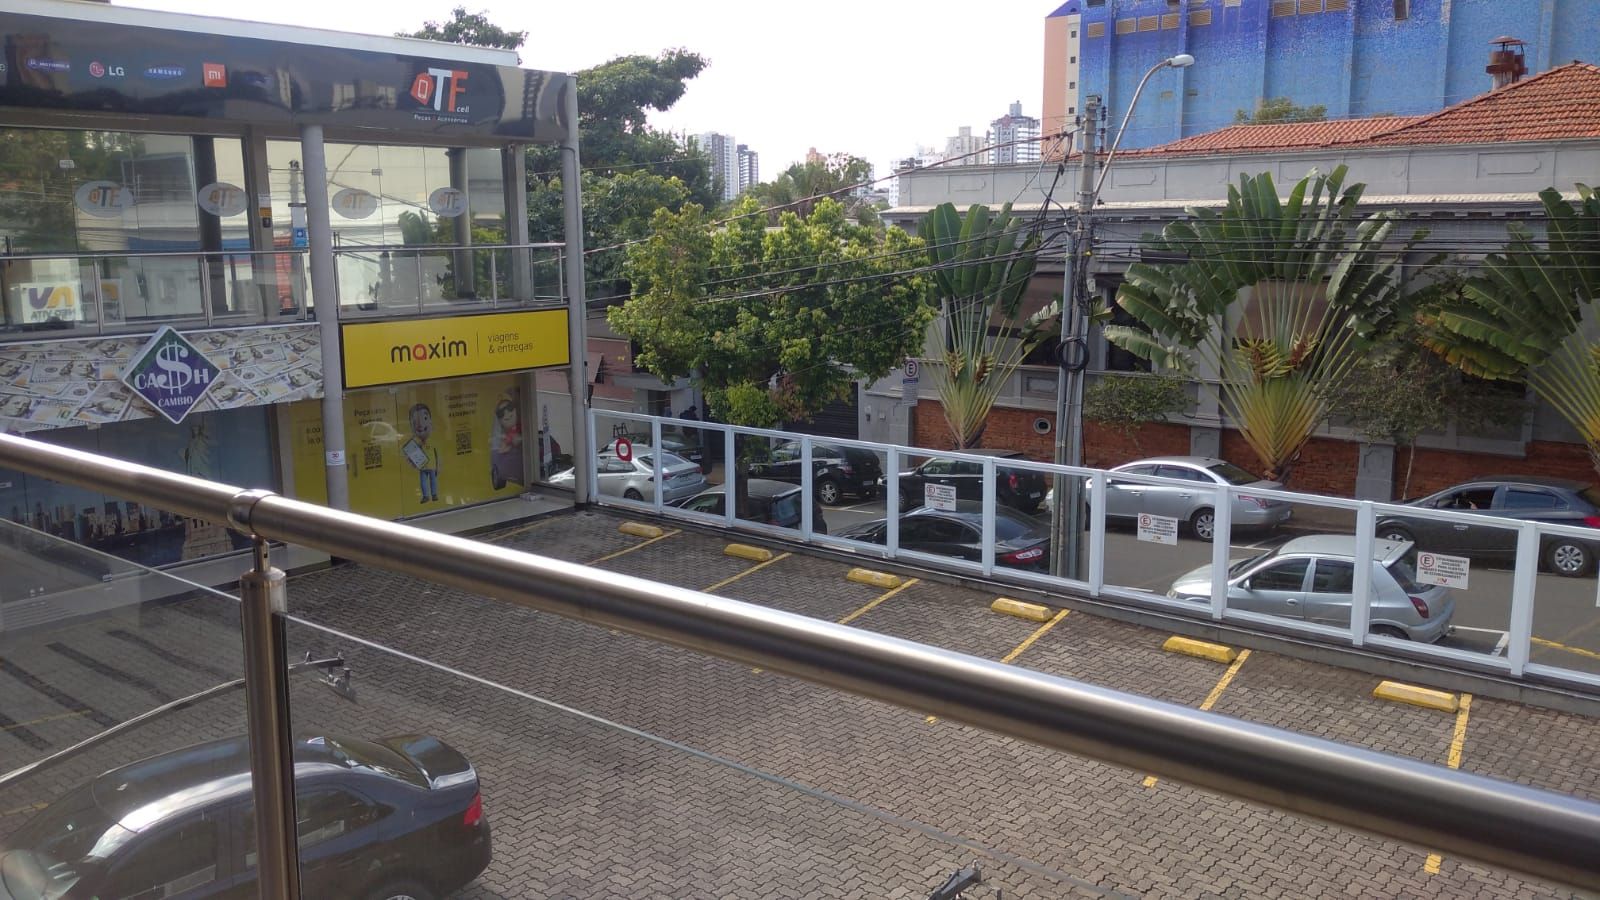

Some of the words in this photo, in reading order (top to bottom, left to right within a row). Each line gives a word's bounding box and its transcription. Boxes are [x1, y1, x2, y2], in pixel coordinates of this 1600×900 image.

[109, 66, 125, 76] LG
[456, 105, 470, 113] cell
[487, 331, 520, 344] viagens
[390, 335, 468, 363] maxim
[488, 344, 495, 354] &
[497, 341, 534, 354] entregas
